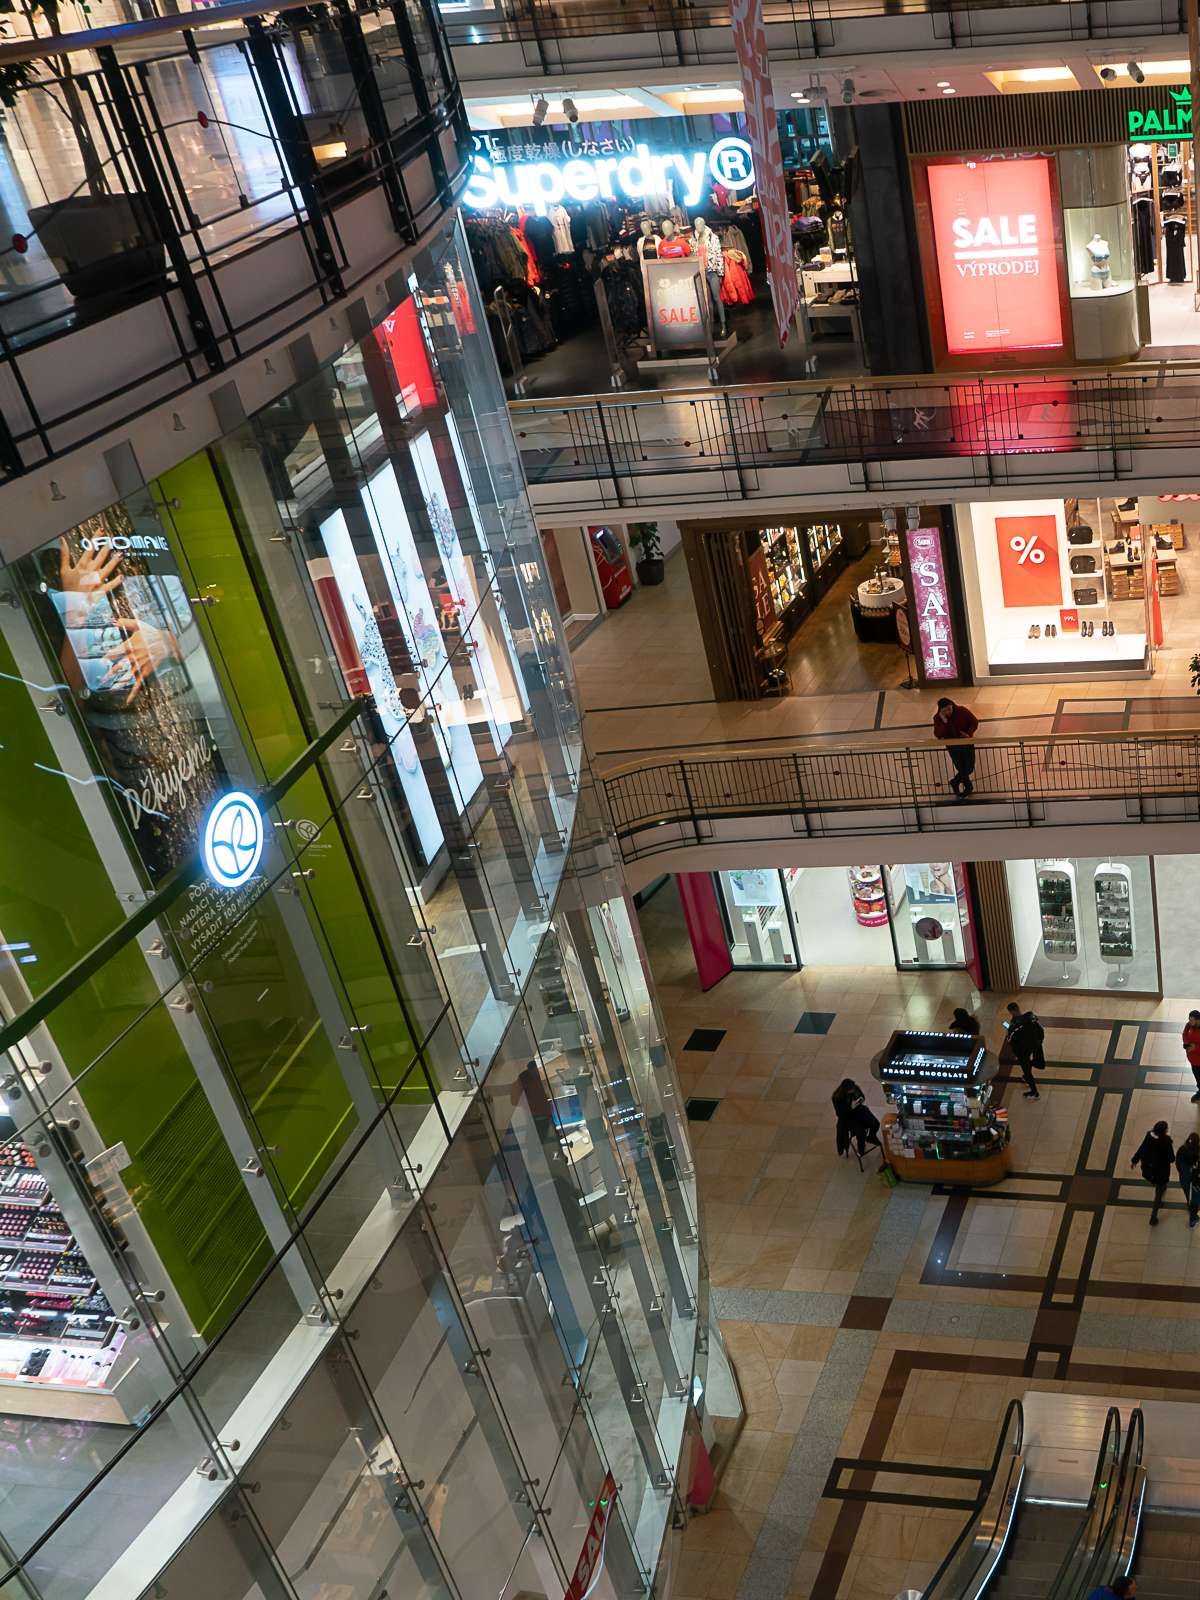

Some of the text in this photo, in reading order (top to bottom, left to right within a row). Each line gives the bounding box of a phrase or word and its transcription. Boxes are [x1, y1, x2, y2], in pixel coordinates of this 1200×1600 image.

[952, 214, 1038, 249] SALE
[956, 260, 1039, 278] VÝPRODEJ
[658, 306, 698, 325] SALE
[918, 561, 951, 669] SALE
[883, 1067, 968, 1079] PRAGUE CHOCOLATE
